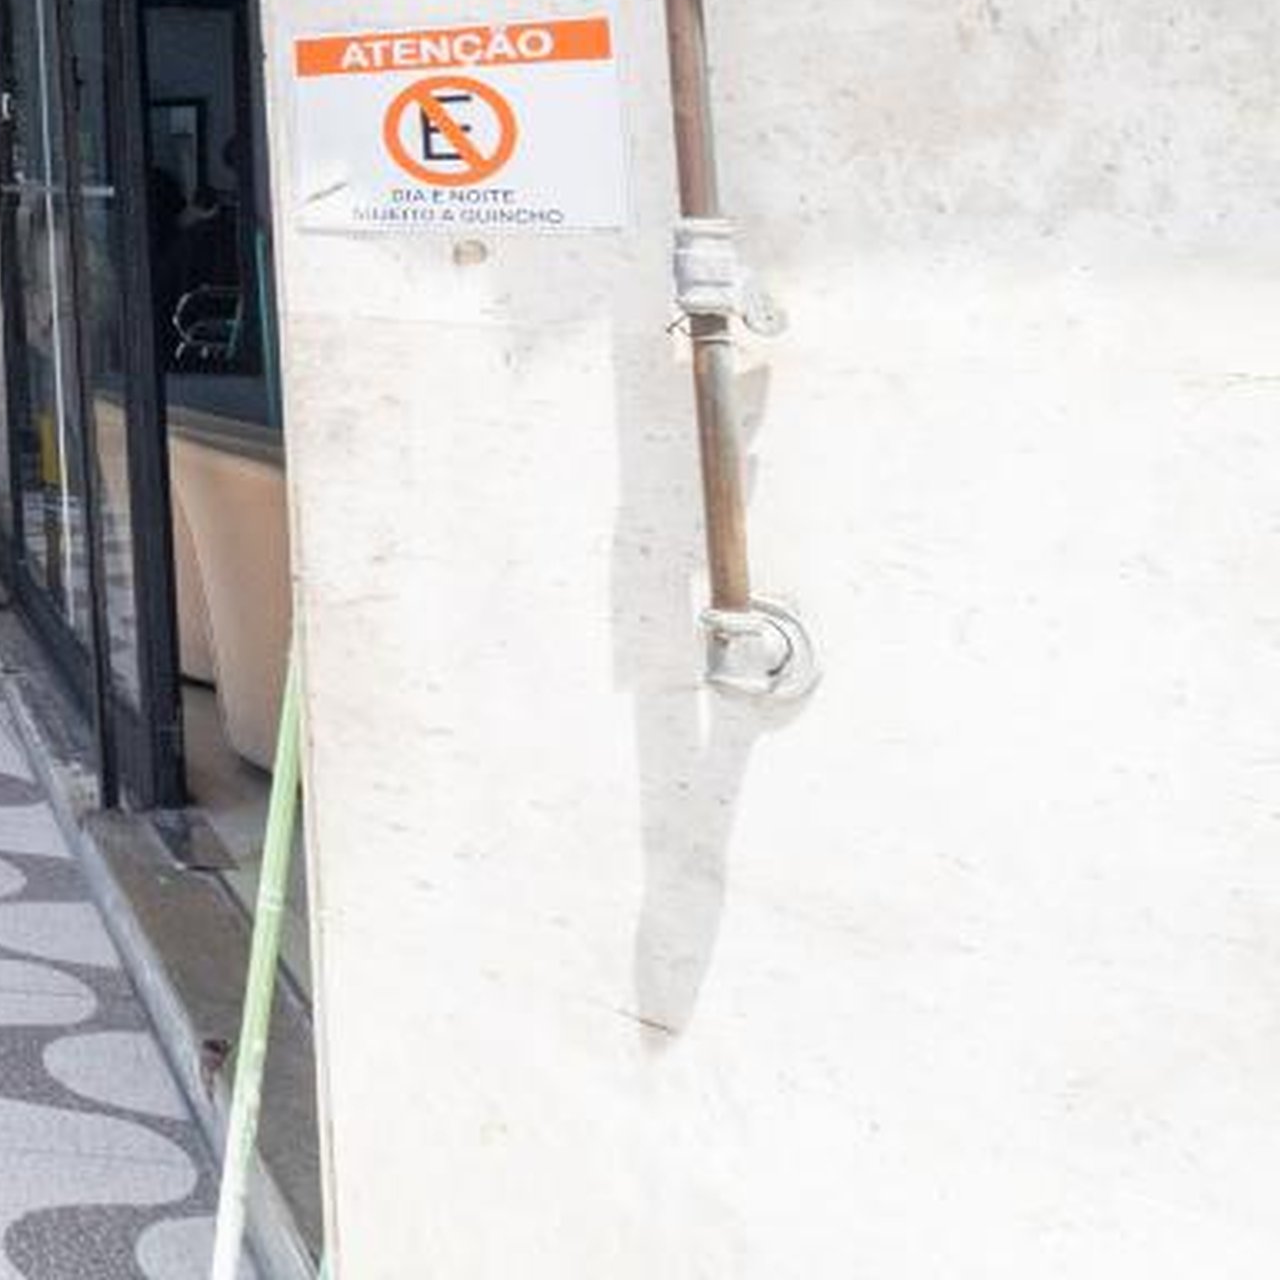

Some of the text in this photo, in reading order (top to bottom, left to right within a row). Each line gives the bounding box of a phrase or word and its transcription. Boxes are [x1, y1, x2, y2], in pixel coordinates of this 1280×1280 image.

[340, 24, 556, 70] ATENÇÃO
[392, 189, 426, 204] DIA
[450, 188, 517, 205] NOITE
